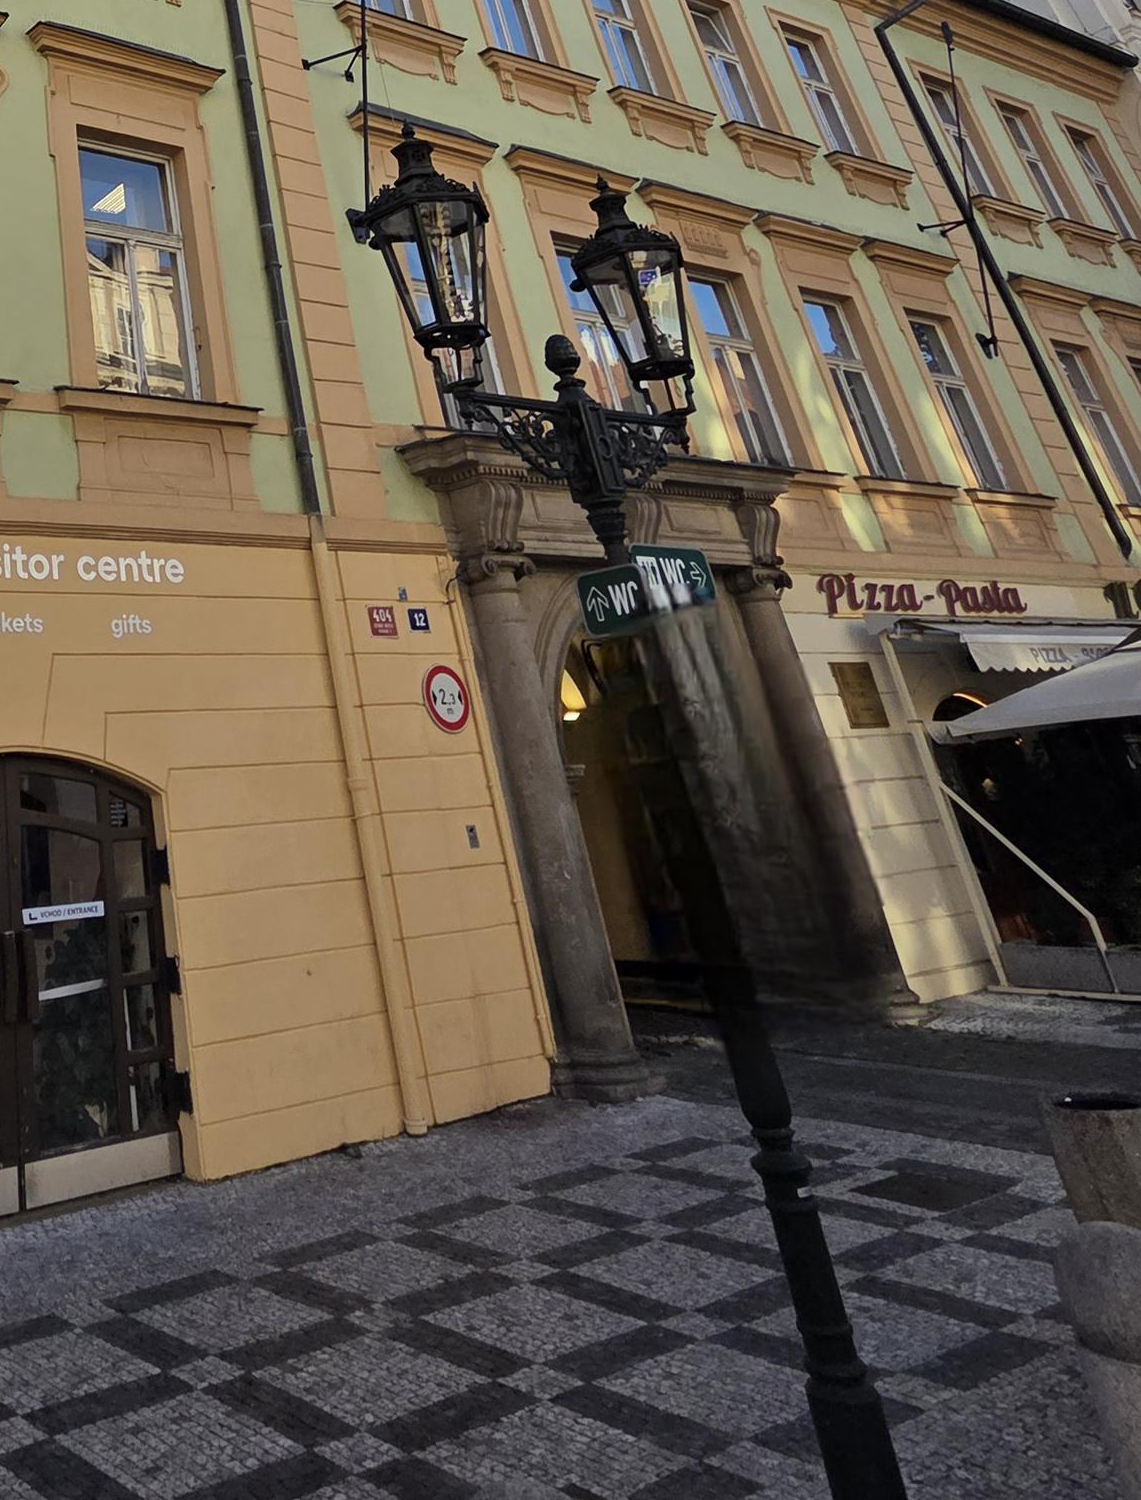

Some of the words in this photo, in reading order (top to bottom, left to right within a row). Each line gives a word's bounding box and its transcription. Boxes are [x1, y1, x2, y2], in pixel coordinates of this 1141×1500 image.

[77, 550, 184, 583] centre
[373, 609, 393, 622] 404
[414, 613, 426, 626] 12
[111, 614, 152, 638] gifts
[67, 905, 99, 916] ENTRANCE
